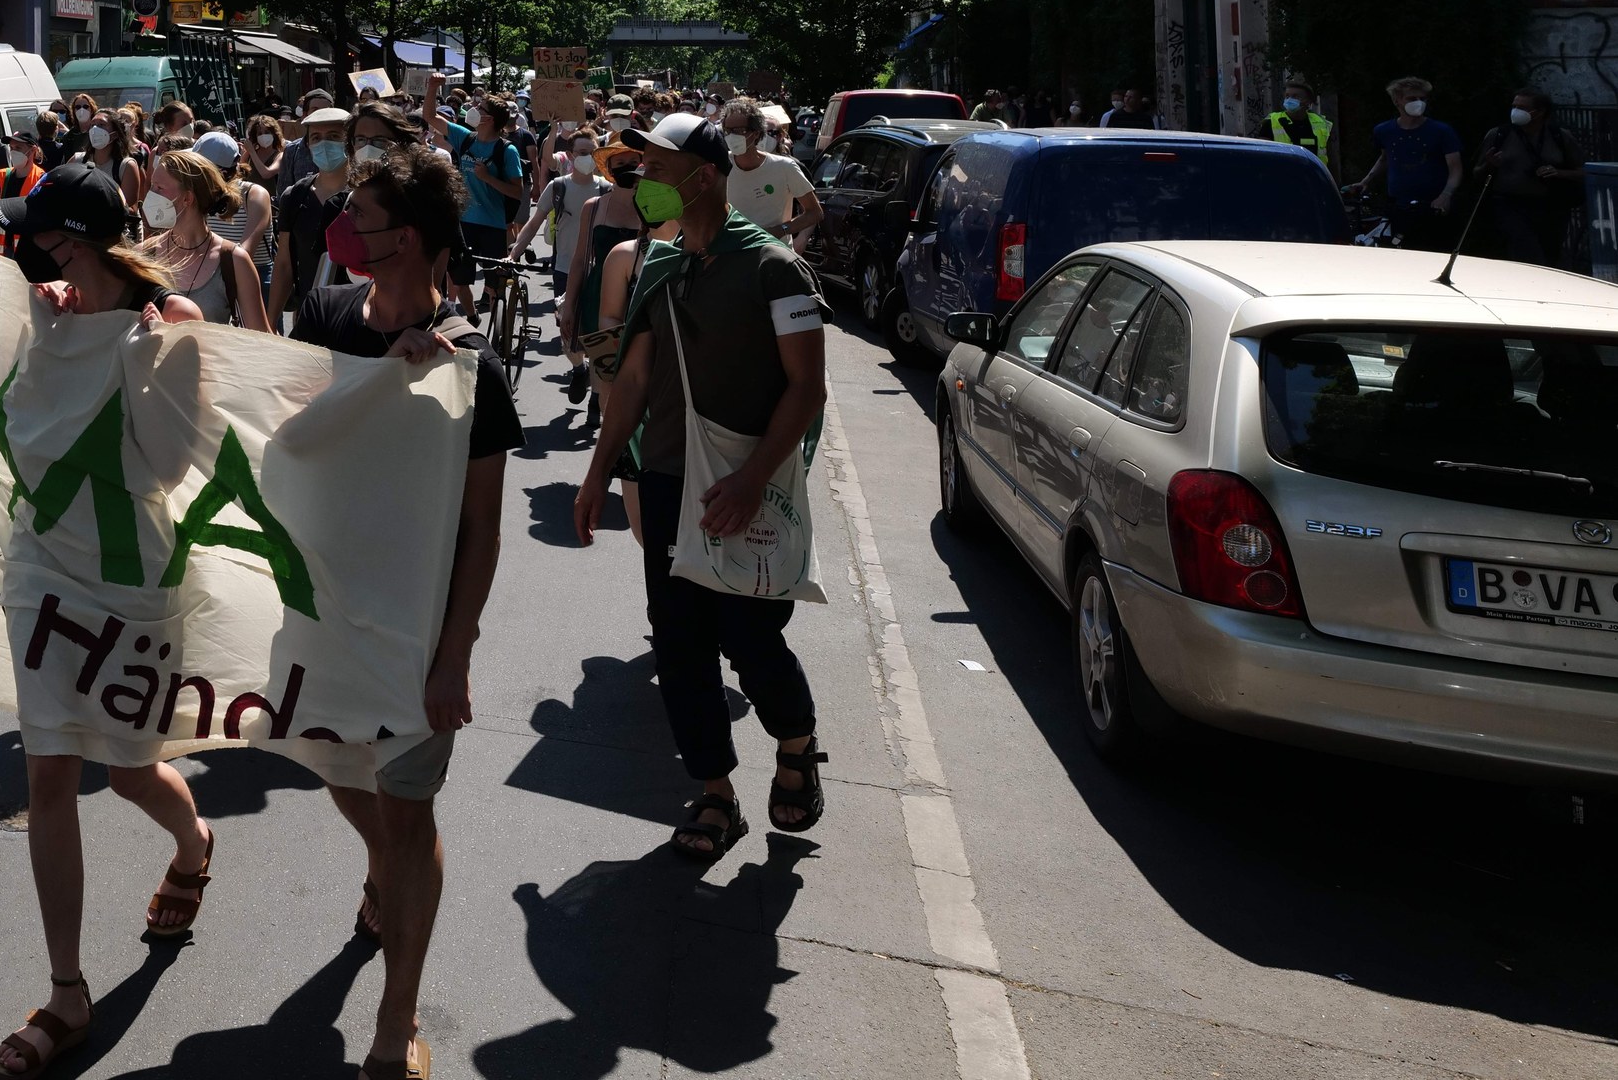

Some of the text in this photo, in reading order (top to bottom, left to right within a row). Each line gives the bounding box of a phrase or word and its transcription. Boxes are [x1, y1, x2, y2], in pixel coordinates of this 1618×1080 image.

[554, 50, 563, 62] to
[565, 51, 587, 64] stay
[535, 64, 574, 80] ALIVE
[64, 218, 87, 233] NASA
[789, 307, 820, 320] ORDNE
[750, 527, 776, 537] KLIMA
[1305, 519, 1383, 540] 323F
[1457, 587, 1469, 599] D
[1477, 567, 1602, 616] B VA
[1486, 610, 1503, 619] Mein
[1526, 614, 1551, 624] Partner
[1570, 620, 1603, 629] mazda
[23, 593, 346, 745] Händ
